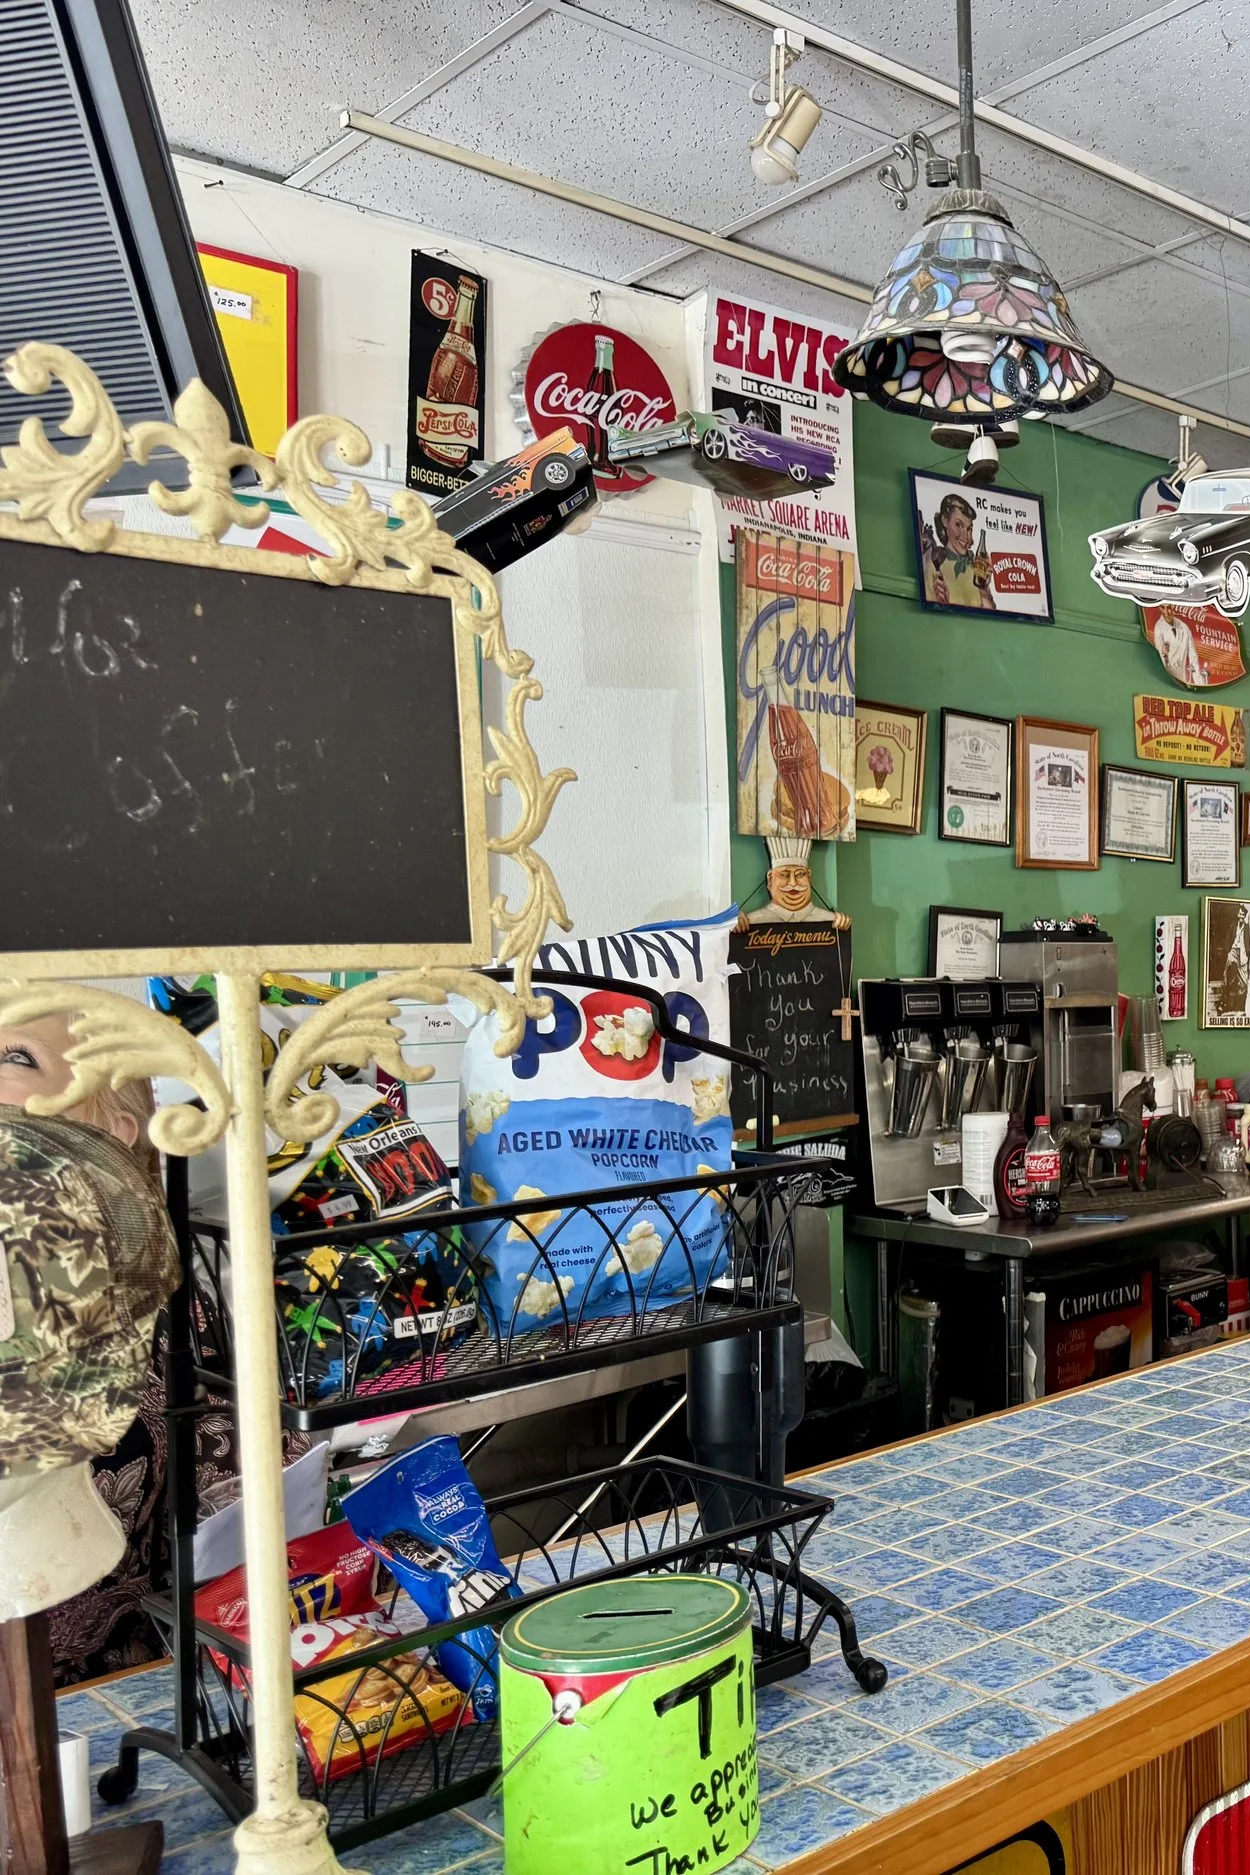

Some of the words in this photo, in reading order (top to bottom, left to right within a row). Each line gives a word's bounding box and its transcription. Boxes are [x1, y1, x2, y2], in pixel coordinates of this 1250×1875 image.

[534, 371, 672, 433] Coca-Cola
[762, 383, 816, 408] concert
[790, 414, 840, 435] INTRODUCING
[790, 425, 804, 435] HIS
[806, 429, 824, 440] NEW
[825, 434, 841, 445] RCA
[976, 497, 988, 510] RC
[990, 502, 1012, 515] makes
[1014, 509, 1027, 519] you
[768, 500, 811, 532] SQUARE
[814, 509, 850, 540] ARENA
[985, 516, 999, 530] feel
[1001, 519, 1013, 532] like
[1015, 522, 1038, 537] NEW!
[744, 517, 797, 539] INDIANAPOLIS,
[797, 533, 828, 546] INDIANA
[757, 553, 834, 593] Coca-Cola
[993, 558, 1013, 575] ROYAL
[1012, 557, 1037, 577] CROWN
[1008, 572, 1026, 582] COLA
[1195, 624, 1237, 643] FOUNTAIN
[1200, 634, 1234, 652] SERVICE
[739, 584, 856, 782] Good
[794, 687, 855, 717] LUNCH
[1142, 697, 1166, 717] RED
[1168, 700, 1192, 719] TOP
[1193, 703, 1214, 723] ALE
[748, 927, 793, 957] Today's
[793, 928, 836, 945] menu
[738, 957, 824, 992] Thank
[1208, 1017, 1229, 1026] SELLING
[1229, 1018, 1235, 1026] IS
[1236, 1018, 1243, 1026] SO
[509, 985, 710, 1083] POP
[368, 1124, 418, 1151] Orleans
[497, 1131, 562, 1156] AGED
[568, 1129, 640, 1152] WHITE
[591, 1153, 659, 1169] POPCORN
[803, 1142, 846, 1161] SALUDA
[615, 1169, 647, 1182] FLAVORED
[572, 1244, 594, 1256] with
[692, 1238, 713, 1252] colors
[561, 1257, 596, 1267] cheese
[1059, 1283, 1140, 1321] CAPPUCCINO
[1190, 1290, 1209, 1303] BUNN
[400, 1320, 417, 1333] NET
[428, 1486, 459, 1507] ALWAYS
[441, 1495, 461, 1509] REAL
[433, 1502, 465, 1523] COCOA
[336, 1551, 371, 1568] FRUCTOSE
[351, 1546, 367, 1557] HIGH
[345, 1558, 364, 1570] CORN
[346, 1564, 367, 1576] SYRUP
[625, 1830, 729, 1875] Thank
